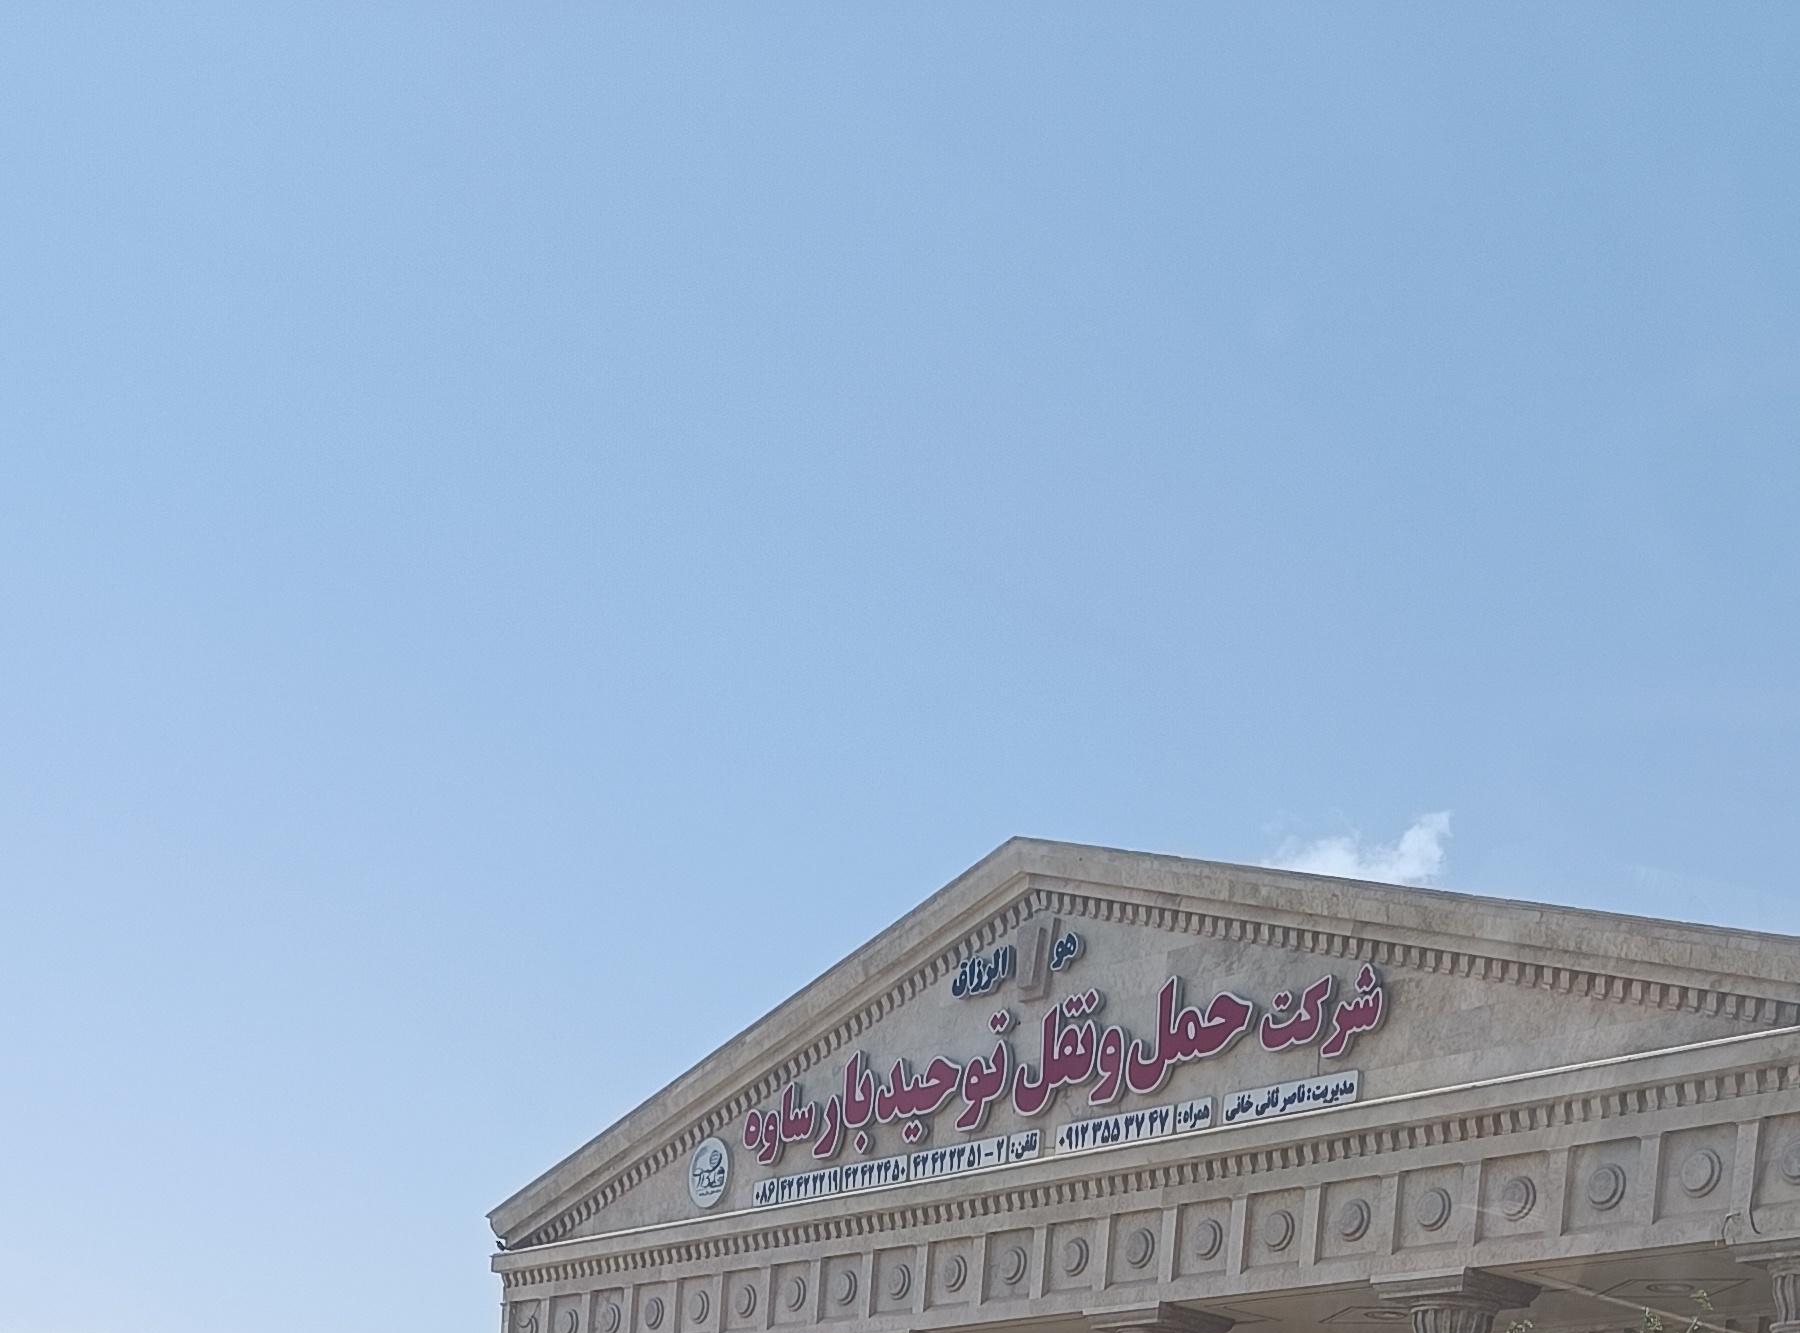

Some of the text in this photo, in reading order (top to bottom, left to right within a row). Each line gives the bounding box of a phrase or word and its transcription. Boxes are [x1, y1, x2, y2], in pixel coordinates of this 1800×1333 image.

[1050, 932, 1078, 970] هو
[1125, 975, 1253, 1095] حمل
[1259, 963, 1383, 1057] شرکت
[743, 1081, 815, 1164] ساوه
[875, 1009, 1008, 1143] توحید
